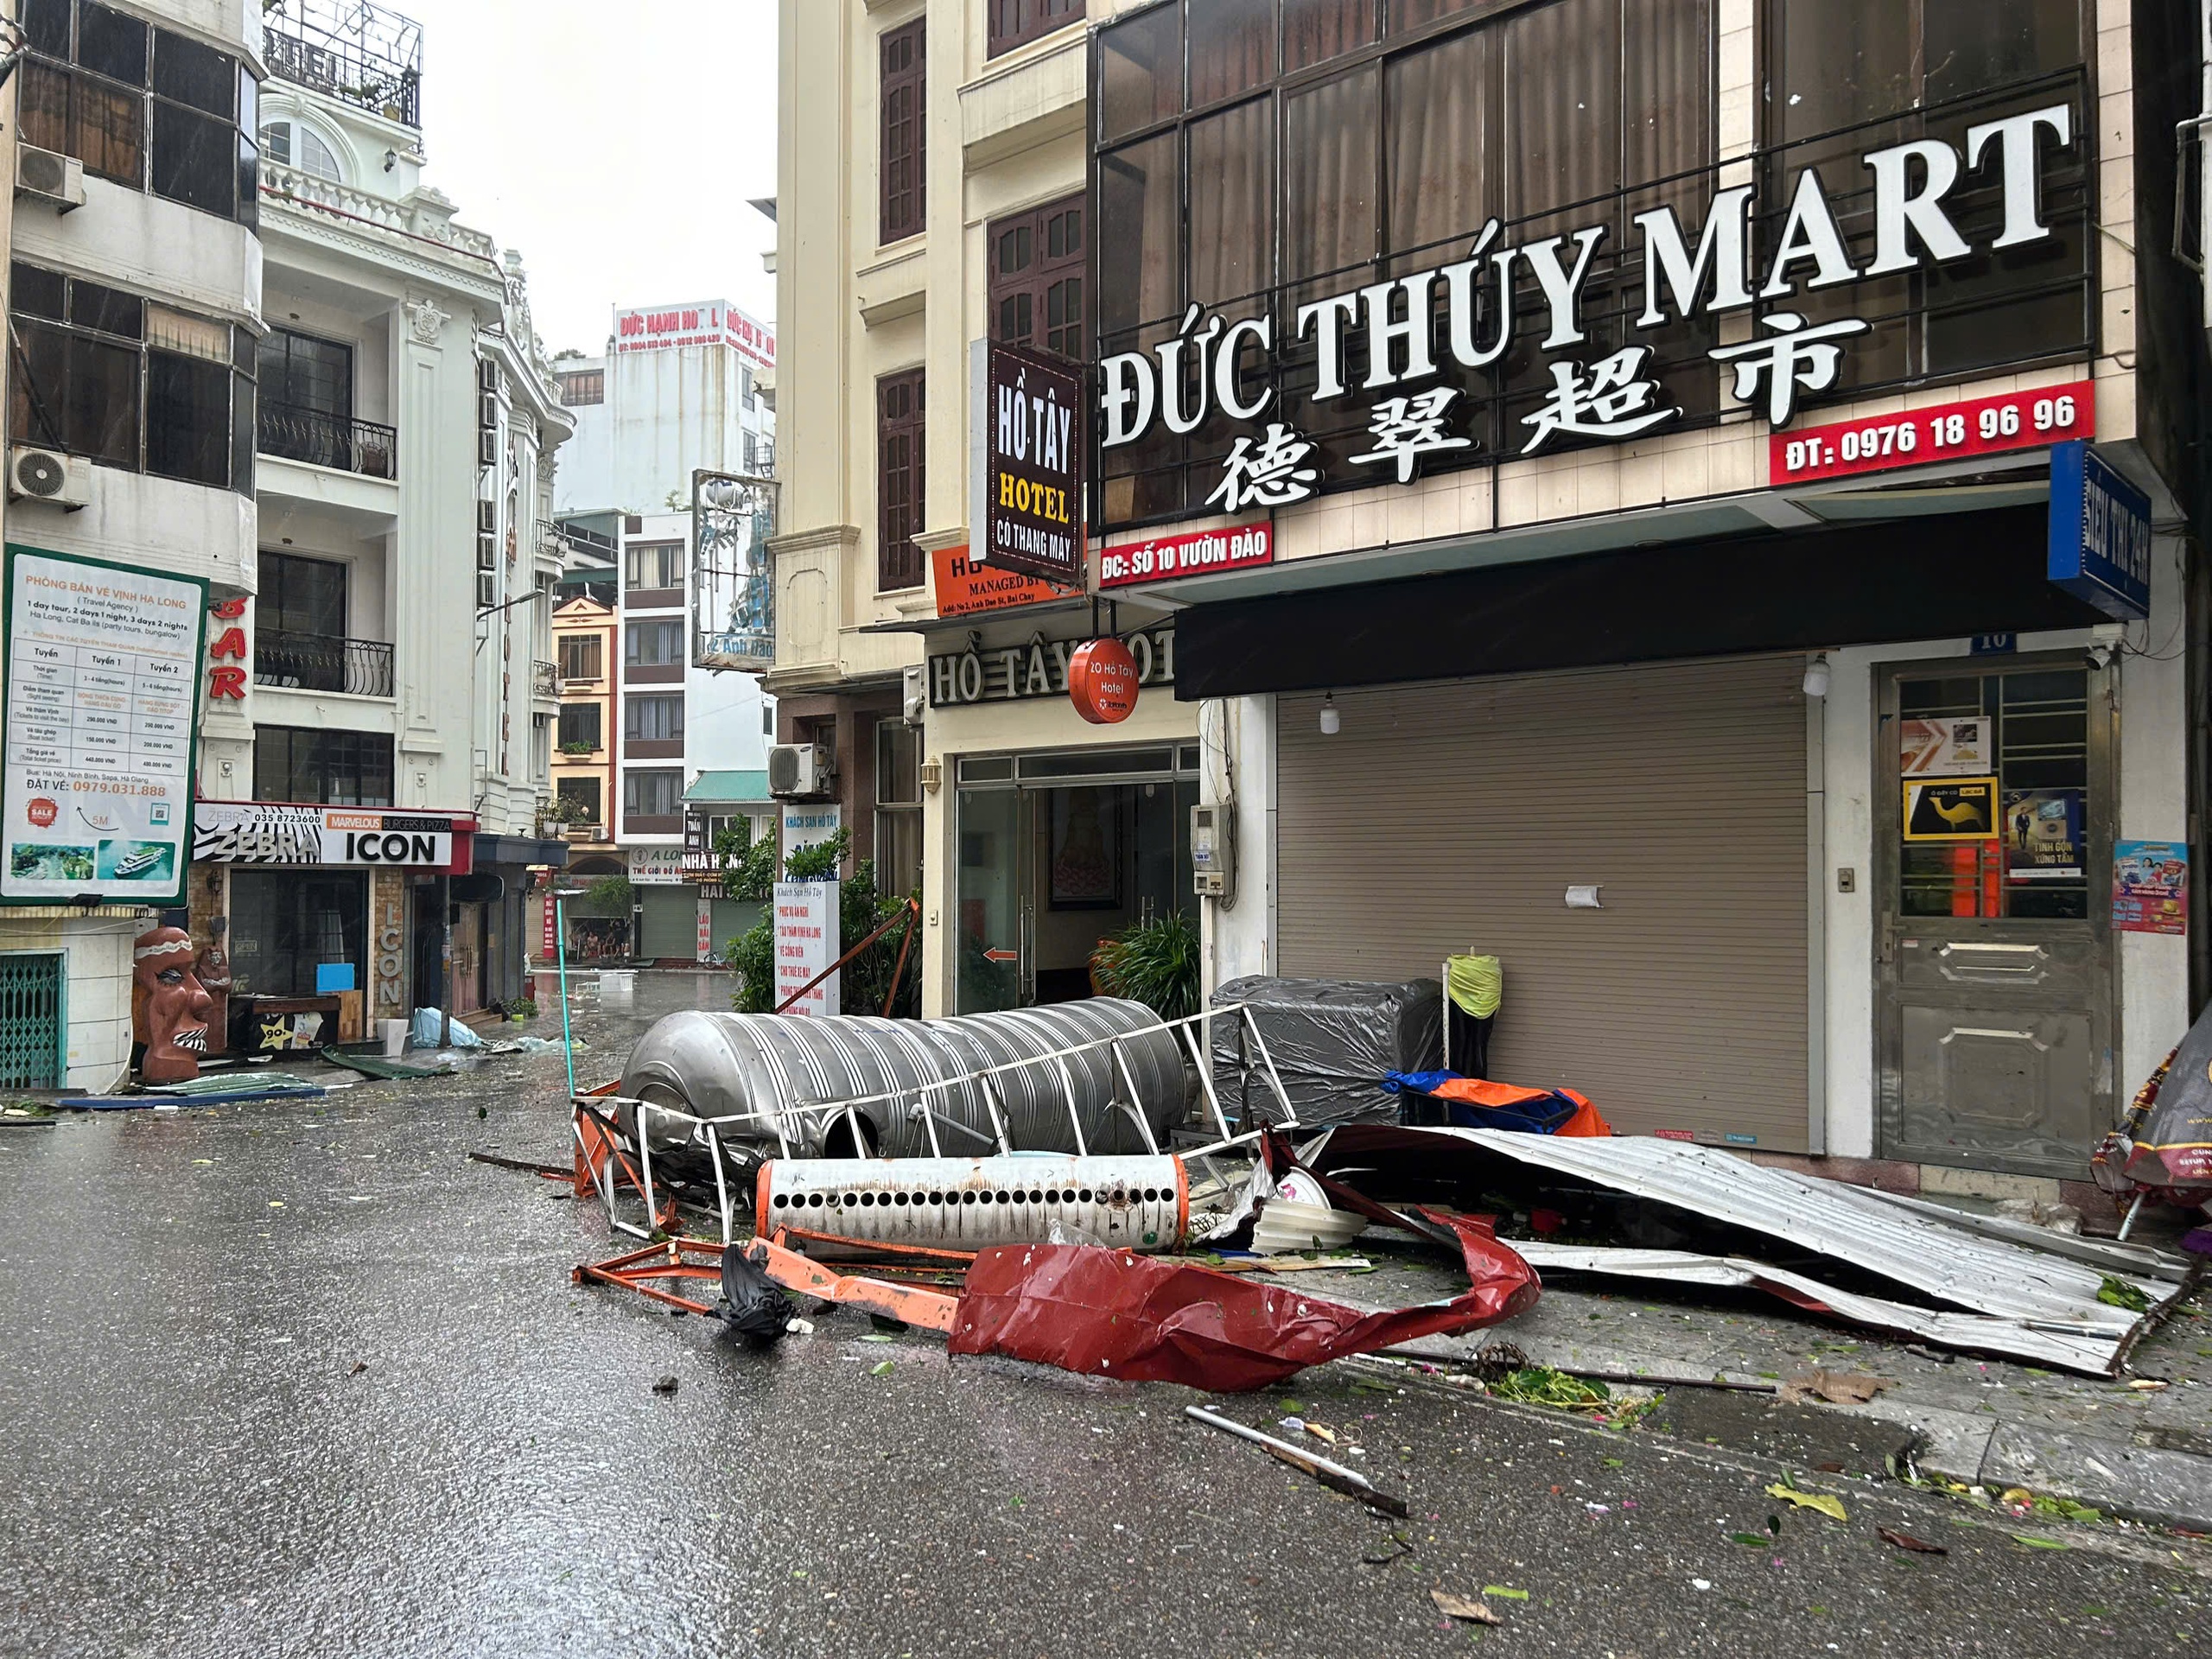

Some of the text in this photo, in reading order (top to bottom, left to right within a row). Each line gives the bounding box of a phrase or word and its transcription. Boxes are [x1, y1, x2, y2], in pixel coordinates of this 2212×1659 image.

[1100, 103, 2071, 449] ĐỨC THÚY MART
[620, 311, 644, 336] ĐỨC
[646, 312, 680, 337] HẠNH
[743, 319, 762, 348] HẠH
[998, 367, 1071, 474] HỒ TÂY
[1785, 396, 2075, 471] ĐT: 0976 18 96 96
[1000, 472, 1069, 524] HOTEL
[996, 517, 1071, 563] CÓ THANG MÁY
[1102, 528, 1267, 580] ĐC: SỐ 10 VƯỜN ĐÀO
[969, 575, 1024, 596] MANAGED
[106, 601, 134, 613] Agency
[112, 588, 137, 601] VỊNH
[140, 594, 155, 606] HẠ
[157, 597, 187, 609] LONG
[33, 601, 49, 611] day
[52, 604, 71, 613] tour,
[79, 607, 99, 619] days
[106, 613, 129, 623] night,
[137, 618, 156, 626] days
[164, 621, 188, 631] nights
[102, 621, 122, 632] (party
[145, 628, 181, 640] bungalow)
[35, 647, 59, 658] Tuyến
[723, 639, 747, 655] Anh
[92, 656, 115, 666] Tuyến
[150, 663, 172, 674] Tuyến
[932, 630, 1078, 703] HỒ TÂY
[1101, 681, 1124, 694] Hotel
[27, 779, 166, 798] ĐẶT VÉ: 0979.031.888
[31, 808, 53, 817] SALE
[208, 810, 321, 823] ZEBRA 035 8723600
[785, 814, 804, 828] KHÁCH
[805, 815, 817, 830] SẠN
[827, 813, 837, 828] TÂY
[332, 817, 380, 829] MARVELOUS
[213, 830, 321, 857] ZEBRA
[346, 832, 435, 861] ICON
[682, 851, 708, 869] NHÀ
[701, 885, 723, 899] HAI
[777, 887, 792, 897] Khách
[793, 887, 803, 898] Sạn
[813, 887, 822, 899] Tây
[378, 902, 402, 1004] ICON
